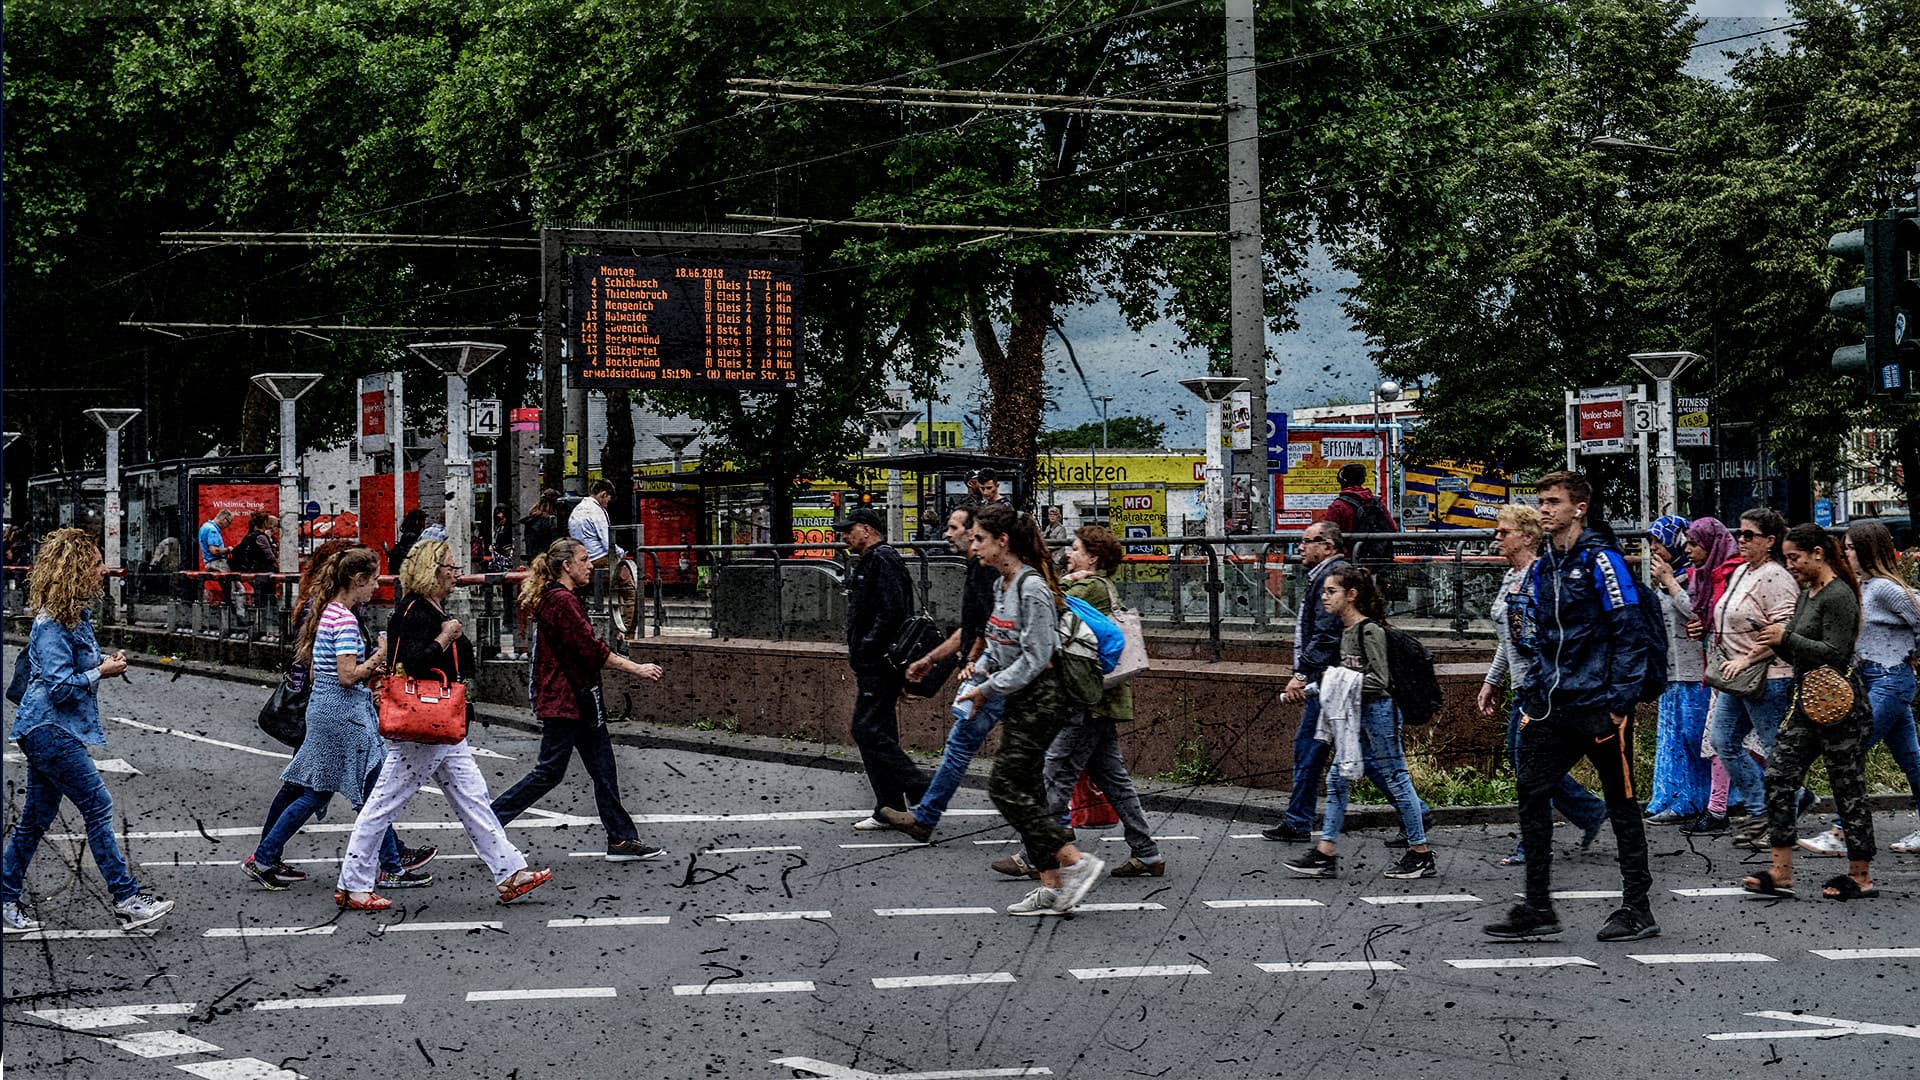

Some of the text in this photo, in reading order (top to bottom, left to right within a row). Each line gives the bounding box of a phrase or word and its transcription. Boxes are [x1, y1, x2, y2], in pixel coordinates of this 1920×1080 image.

[601, 266, 772, 279] Montag 18.06.2018 15:22
[605, 278, 658, 288] Schlebusch
[717, 280, 740, 290] Gleis
[746, 281, 751, 290] 1
[766, 281, 771, 290] 1
[776, 282, 791, 291] Min
[592, 289, 597, 298] 3
[605, 289, 668, 299] Thielenbruch
[746, 292, 751, 301] 1
[776, 293, 791, 302] Min
[592, 300, 597, 309] 3
[605, 301, 653, 311] Mengenich
[717, 303, 740, 312] Gleis
[746, 303, 751, 312] 2
[776, 304, 792, 313] Min
[587, 311, 597, 321] 13
[717, 314, 740, 323] Gleis
[776, 315, 792, 324] Min
[582, 322, 597, 332] 143
[776, 326, 792, 335] Min
[582, 334, 597, 343] 143
[776, 338, 792, 346] Min
[587, 345, 597, 355] 13
[605, 345, 657, 356] Sülzgürtel
[776, 349, 792, 358] Min
[605, 357, 660, 367] Bocklemünd
[717, 359, 741, 368] Gleis
[746, 359, 752, 368] 2
[776, 360, 792, 369] Min
[725, 370, 755, 380] Herler
[761, 370, 780, 380] Str.
[1677, 398, 1709, 407] FITNESS
[479, 410, 497, 432] 4
[1637, 410, 1650, 429] 3
[1683, 414, 1703, 427] 15,95
[1329, 440, 1364, 457] FESTIVAL
[1124, 496, 1151, 509] MFO
[1115, 512, 1160, 522] Matratzen
